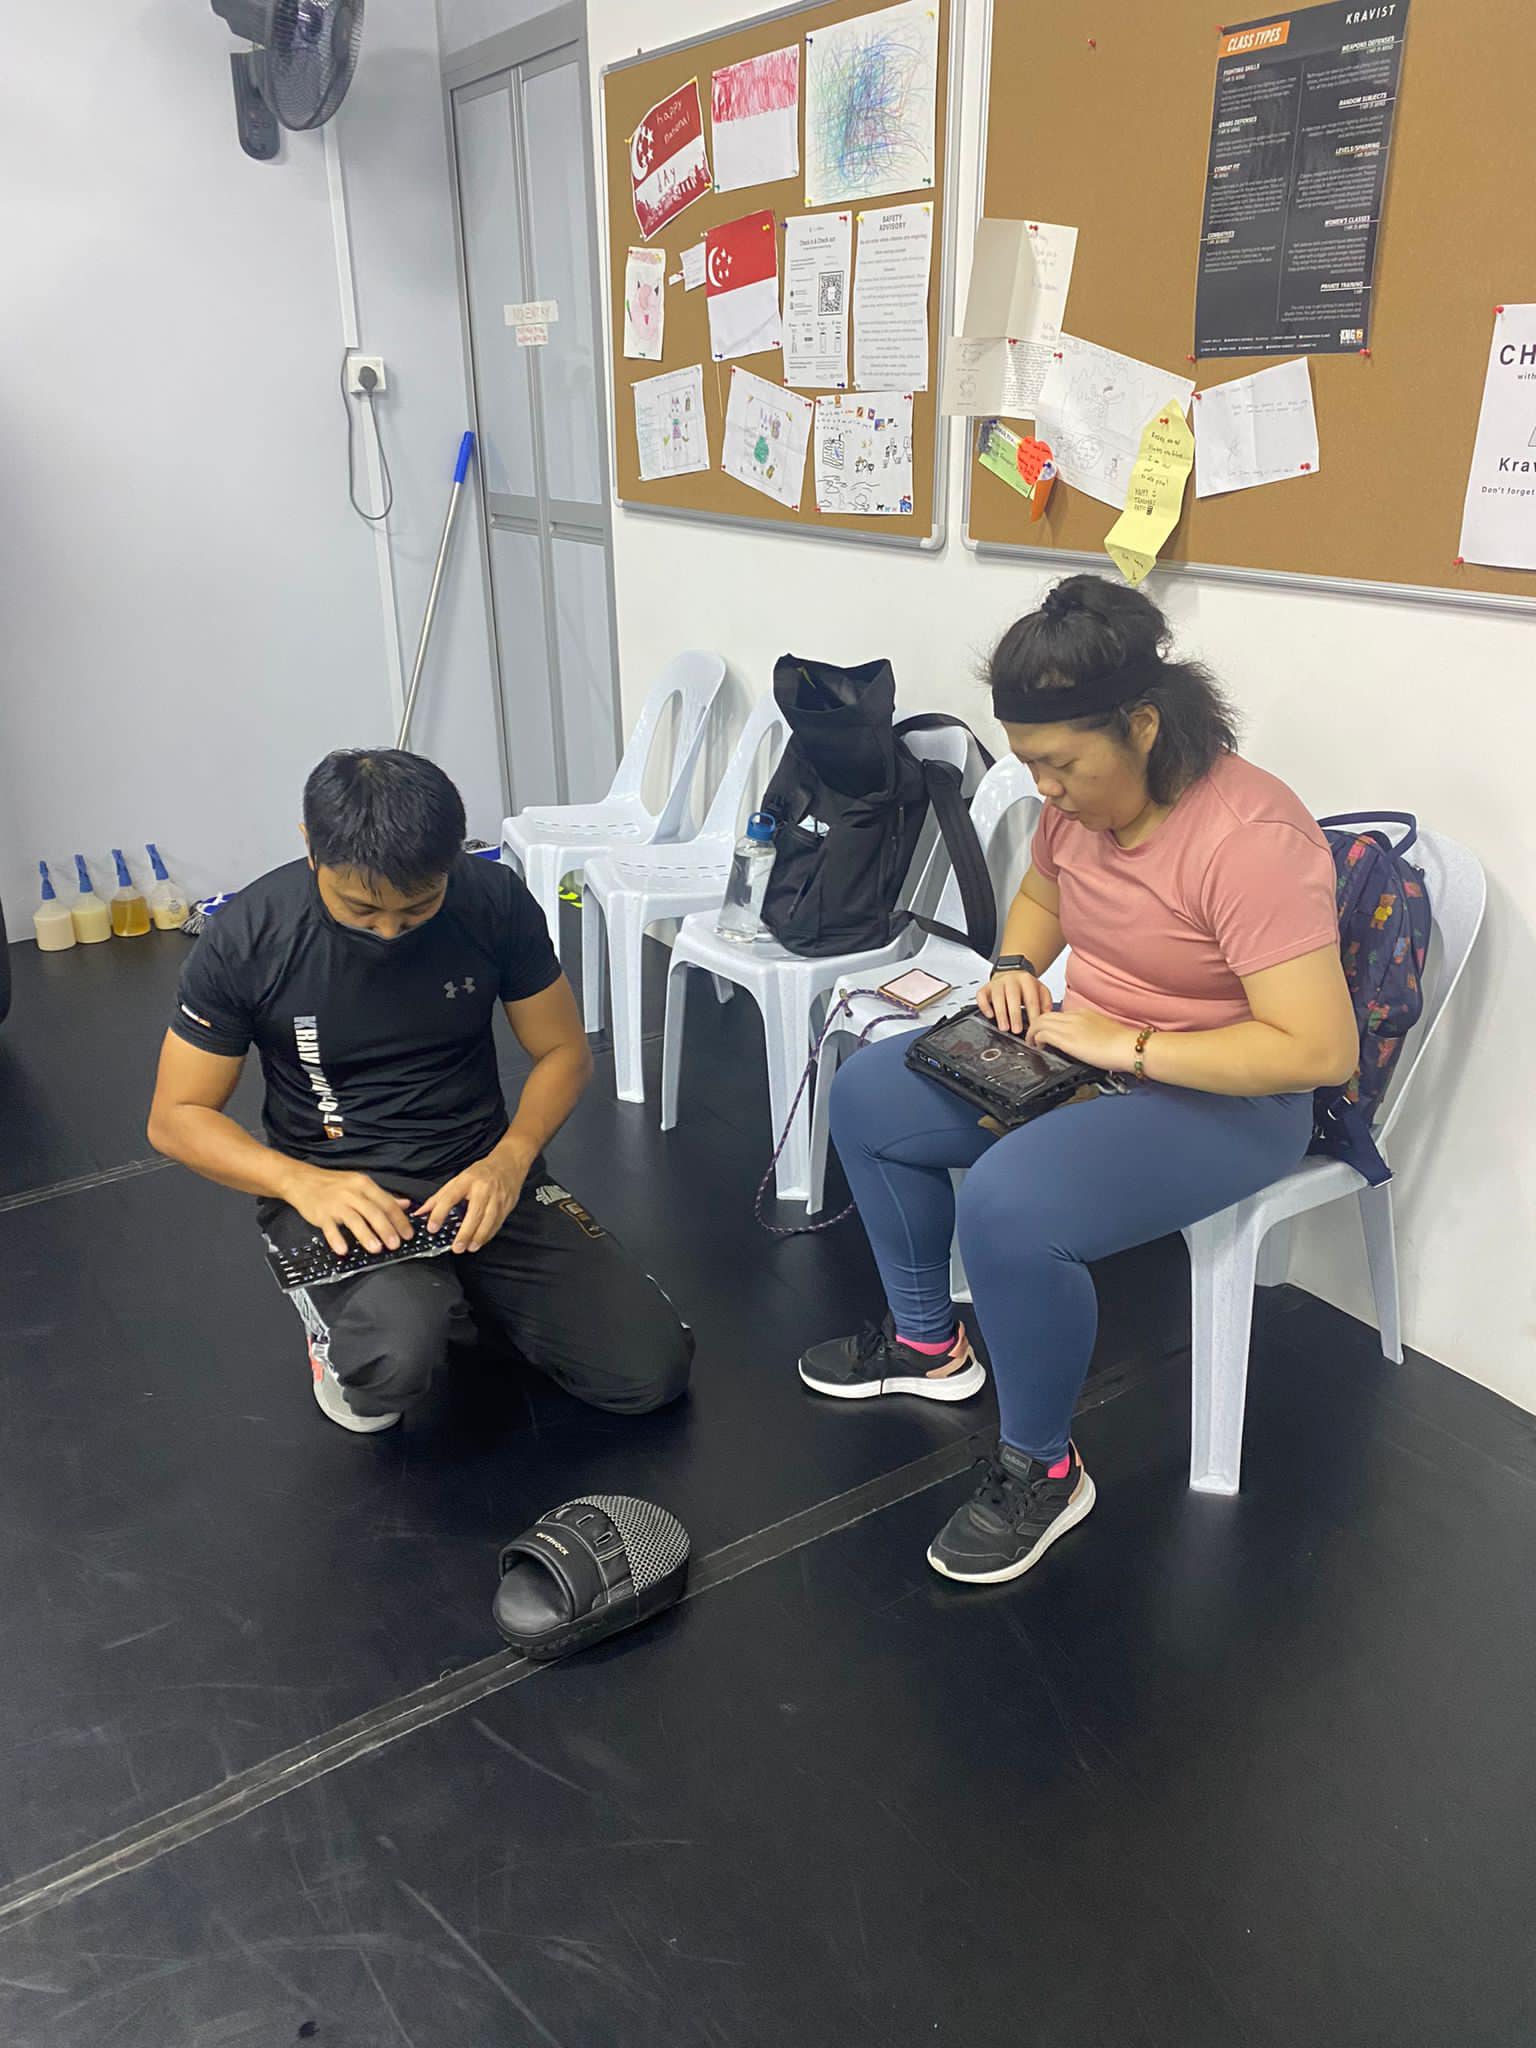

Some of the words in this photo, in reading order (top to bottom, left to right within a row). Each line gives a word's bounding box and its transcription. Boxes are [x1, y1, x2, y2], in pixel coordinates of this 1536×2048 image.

[1345, 4, 1396, 25] KRAVIST
[1227, 33, 1255, 52] CLASS
[1254, 27, 1282, 46] TYPES
[880, 222, 907, 231] ADVISORY
[882, 214, 903, 223] SAFETY
[1481, 486, 1505, 495] Don't
[1507, 487, 1536, 497] forget
[294, 1016, 320, 1064] KRAV
